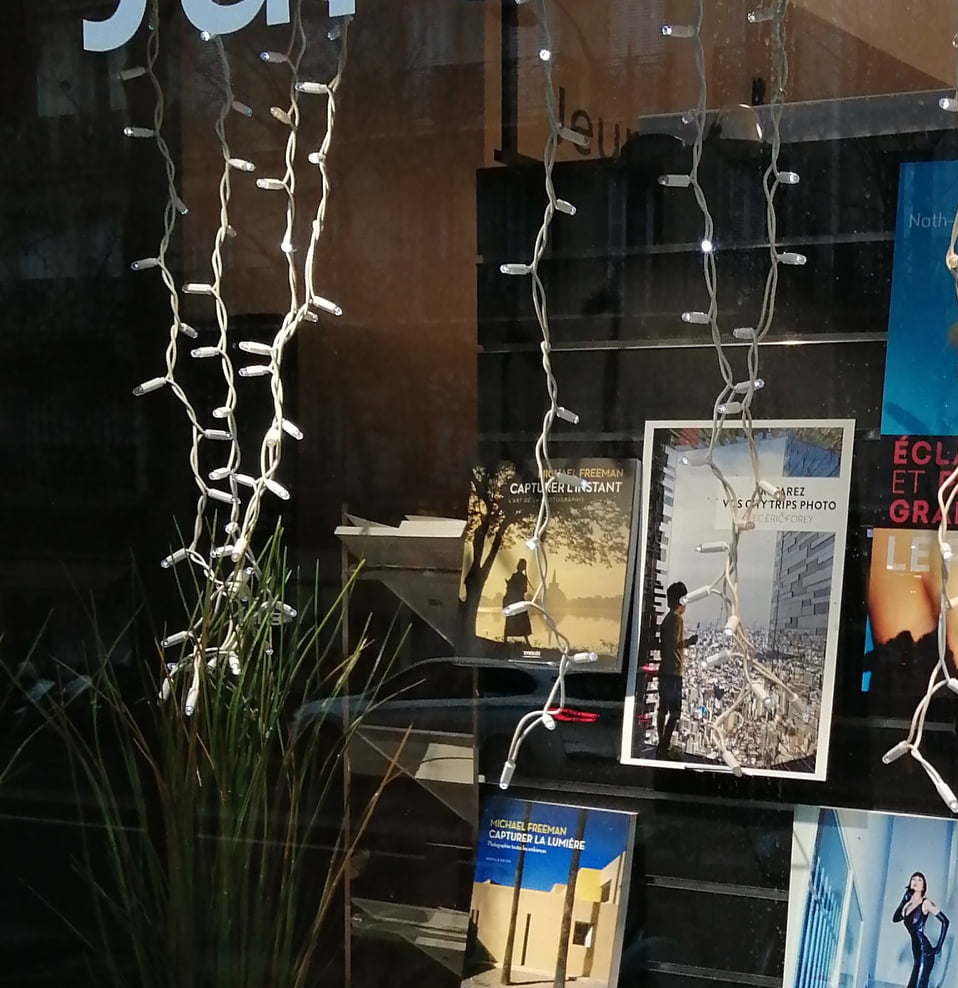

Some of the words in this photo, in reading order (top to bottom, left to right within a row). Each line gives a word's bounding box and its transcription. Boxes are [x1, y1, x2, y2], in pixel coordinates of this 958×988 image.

[579, 468, 624, 478] FREEMAN
[892, 470, 926, 494] ET
[770, 500, 798, 510] TRIPS
[800, 500, 837, 510] PHOTO
[886, 536, 931, 572] LE
[490, 819, 526, 831] MICHAEL
[528, 822, 567, 836] FREEMAN
[489, 830, 532, 844] CAPTURER
[534, 835, 546, 845] LA
[548, 836, 586, 850] LUMIÈRE
